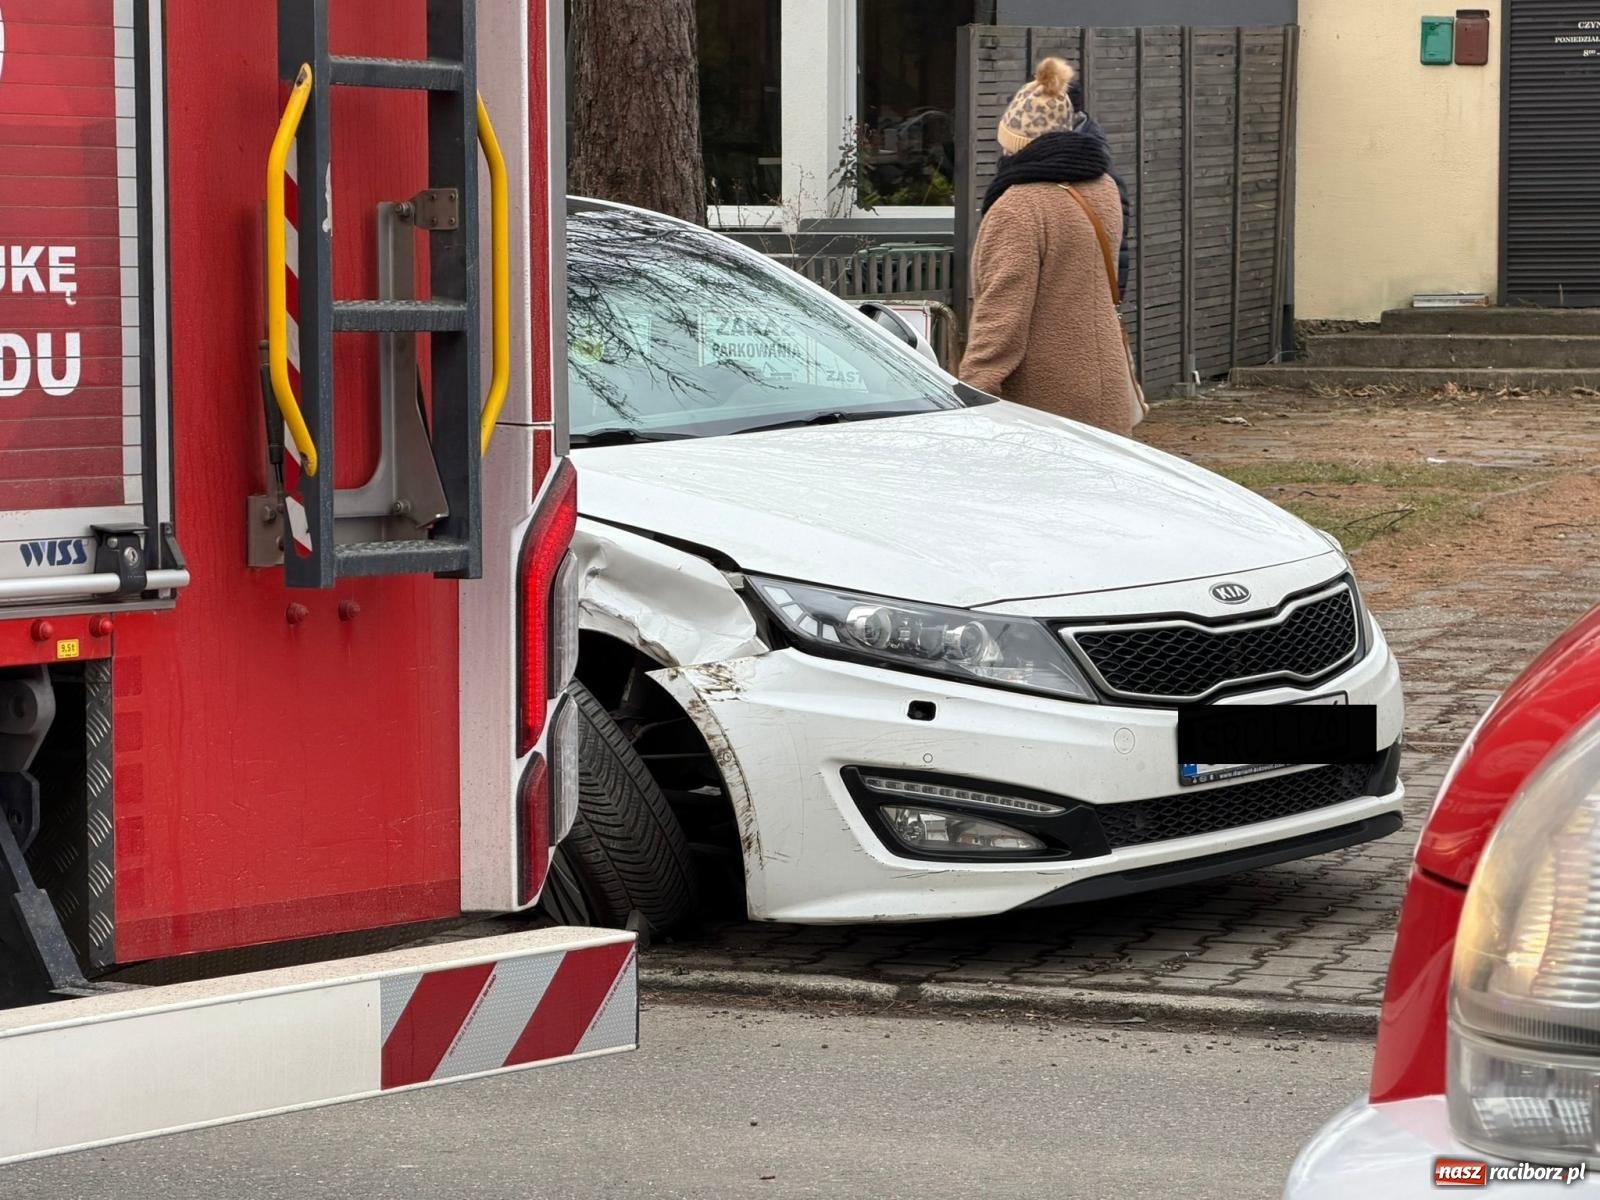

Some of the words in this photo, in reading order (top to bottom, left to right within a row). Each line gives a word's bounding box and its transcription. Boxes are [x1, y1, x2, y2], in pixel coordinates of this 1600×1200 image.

[0, 245, 77, 305] KĘ
[0, 332, 81, 396] DU
[19, 539, 88, 568] WISS
[1215, 585, 1247, 600] KIA
